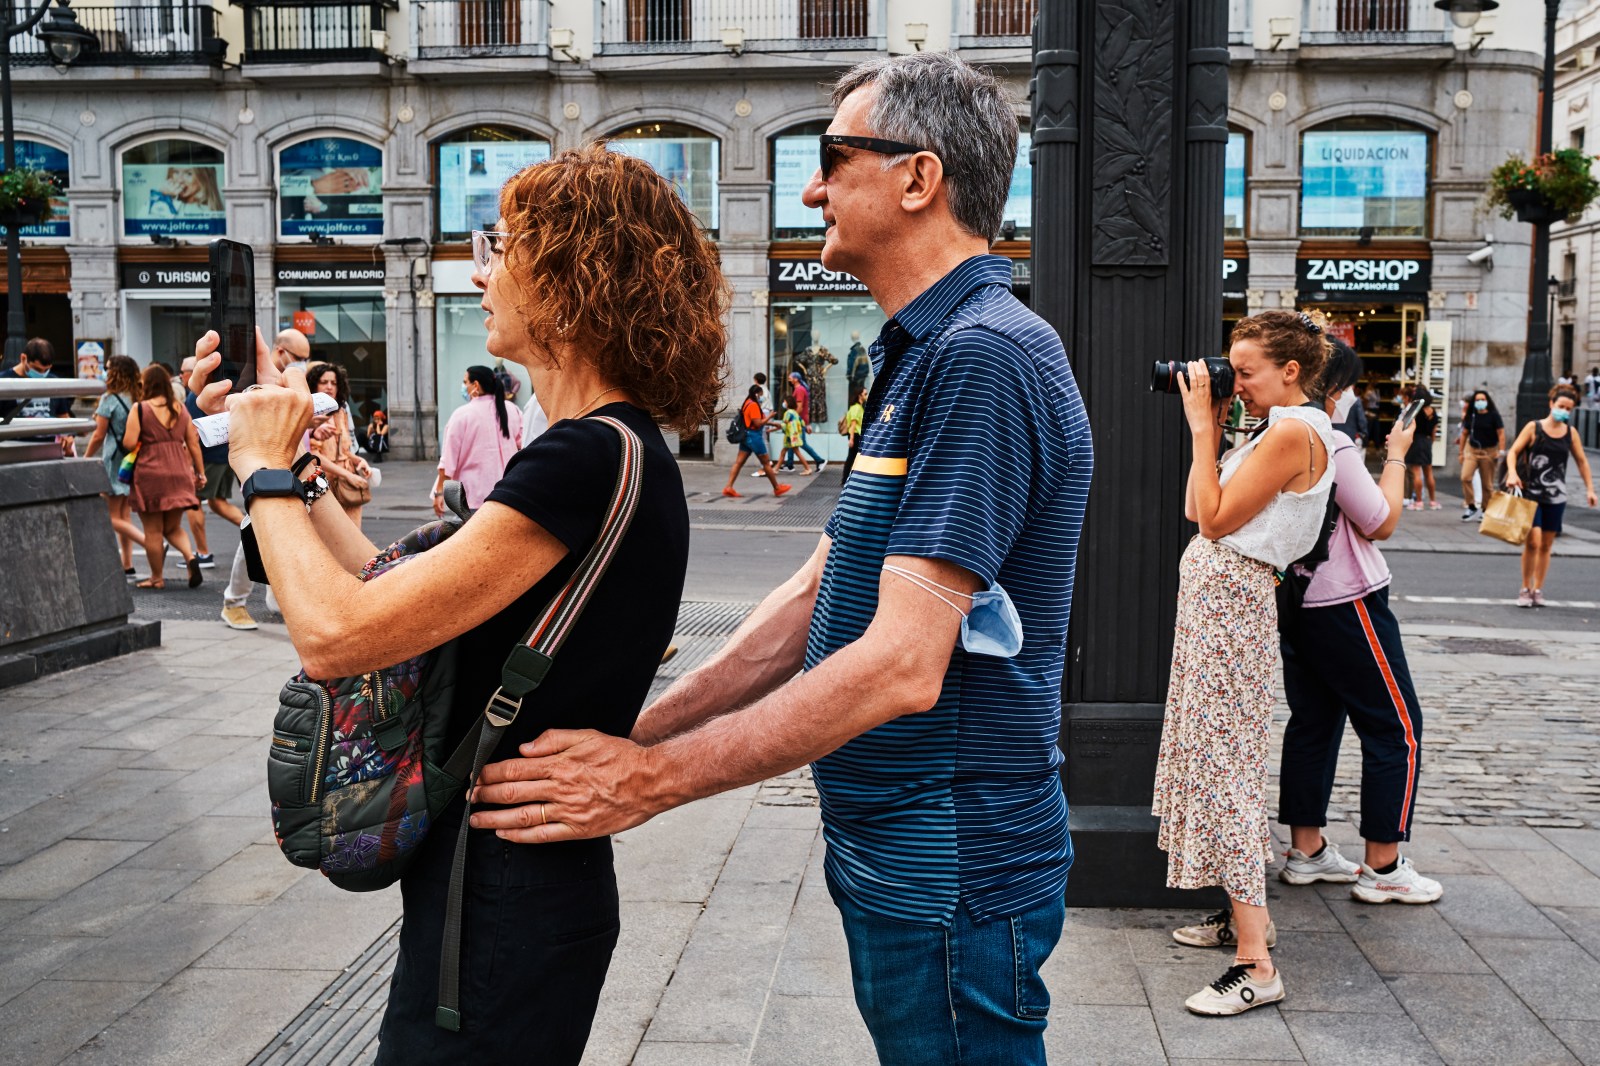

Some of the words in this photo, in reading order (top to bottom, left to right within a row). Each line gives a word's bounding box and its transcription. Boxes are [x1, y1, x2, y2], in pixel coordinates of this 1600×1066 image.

[141, 221, 210, 232] www.jolfer.es
[298, 223, 367, 233] www.jolfer.es
[278, 271, 332, 280] COMUNIDAD
[335, 271, 347, 280] DE
[349, 271, 385, 280] MADRID
[778, 262, 861, 282] ZAPS
[1306, 260, 1420, 281] ZAPSHOP
[156, 271, 211, 283] TURISMO
[1322, 282, 1400, 291] WWW.ZAPSHOP.ES
